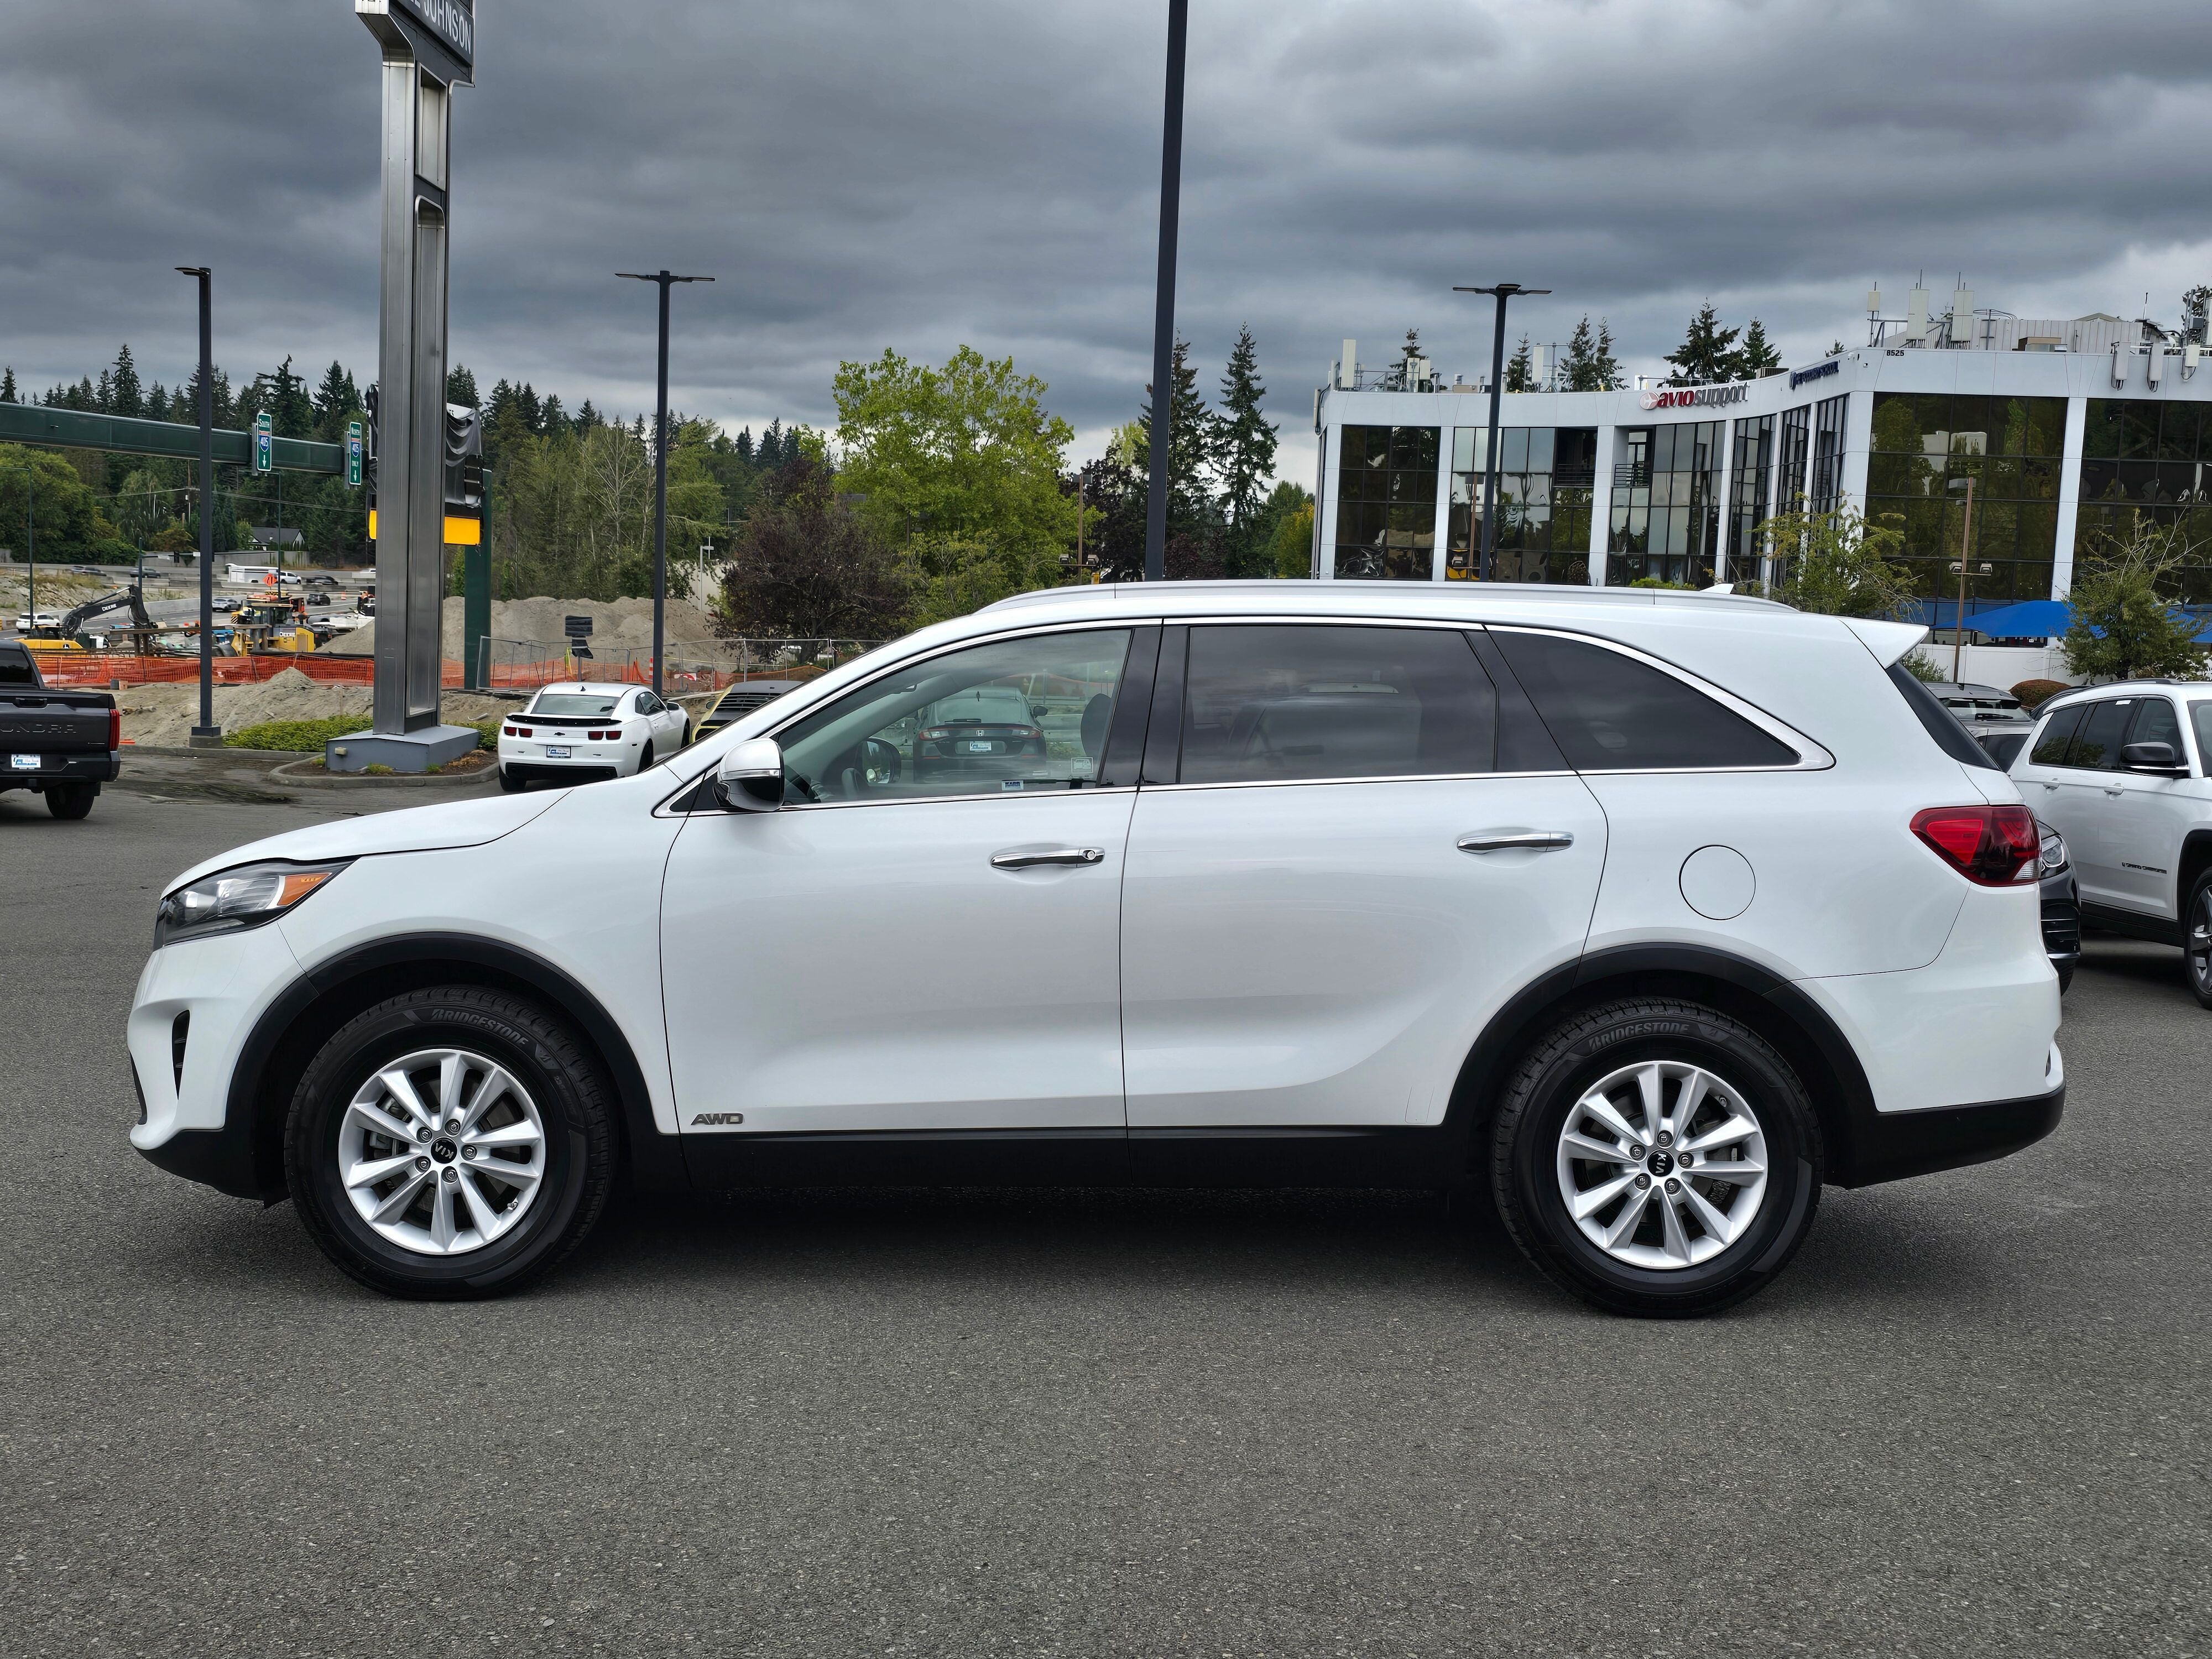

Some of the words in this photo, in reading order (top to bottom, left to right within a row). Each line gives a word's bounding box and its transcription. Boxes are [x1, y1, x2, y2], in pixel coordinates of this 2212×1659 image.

[424, 0, 471, 55] JOHNSON
[430, 1008, 529, 1045] BRIDGESTONE
[1588, 1022, 1689, 1051] BRIDGESTONE
[691, 1113, 744, 1125] AWD
[435, 1142, 454, 1159] KIA
[1655, 1153, 1667, 1173] KIA
